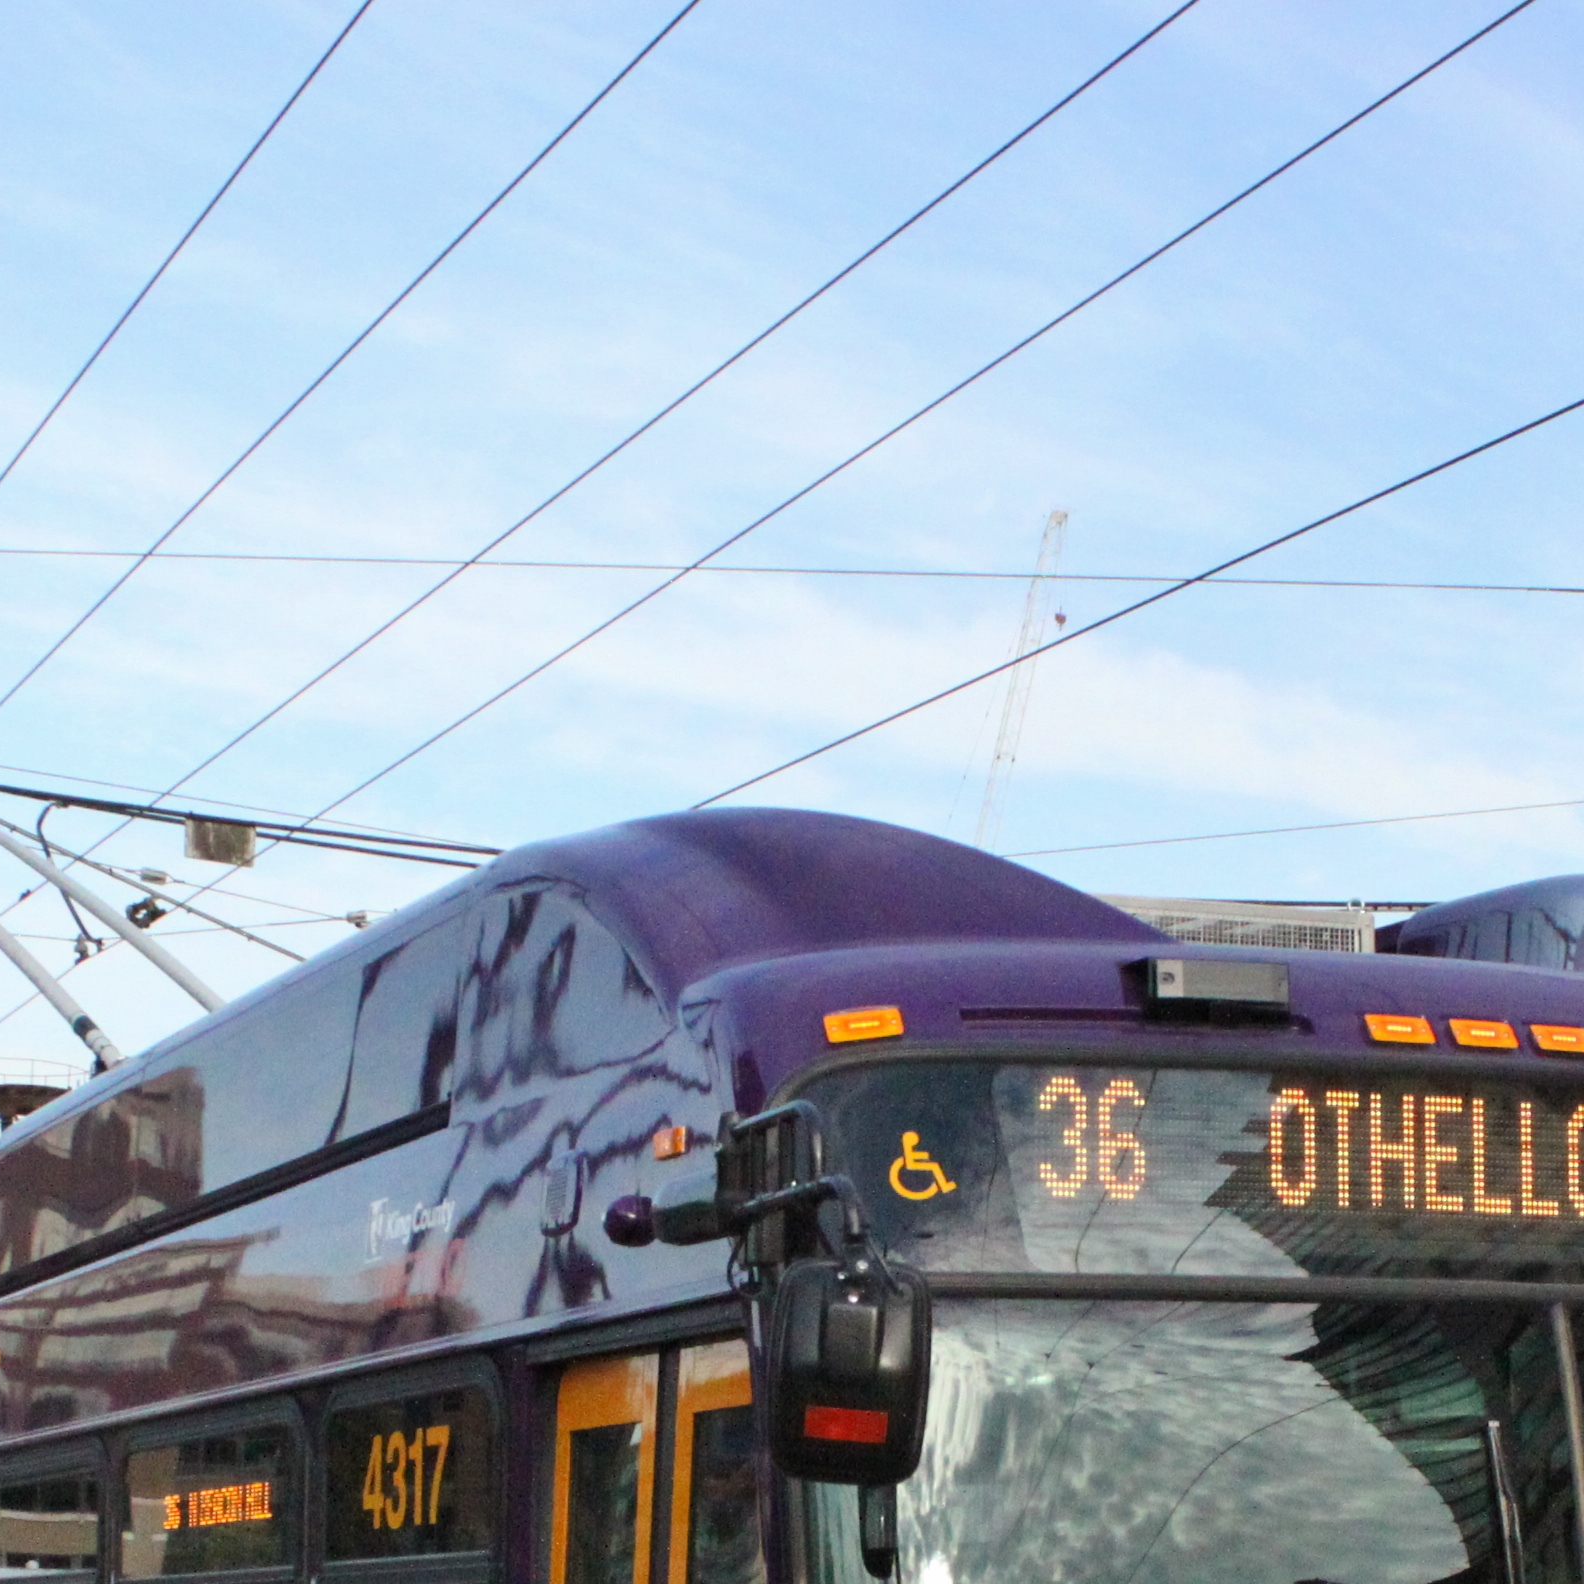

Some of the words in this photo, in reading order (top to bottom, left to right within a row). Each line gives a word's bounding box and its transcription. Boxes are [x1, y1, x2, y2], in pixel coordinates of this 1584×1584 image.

[1039, 1076, 1146, 1199] 36
[245, 1481, 273, 1521] HILL
[362, 1424, 451, 1530] 4317
